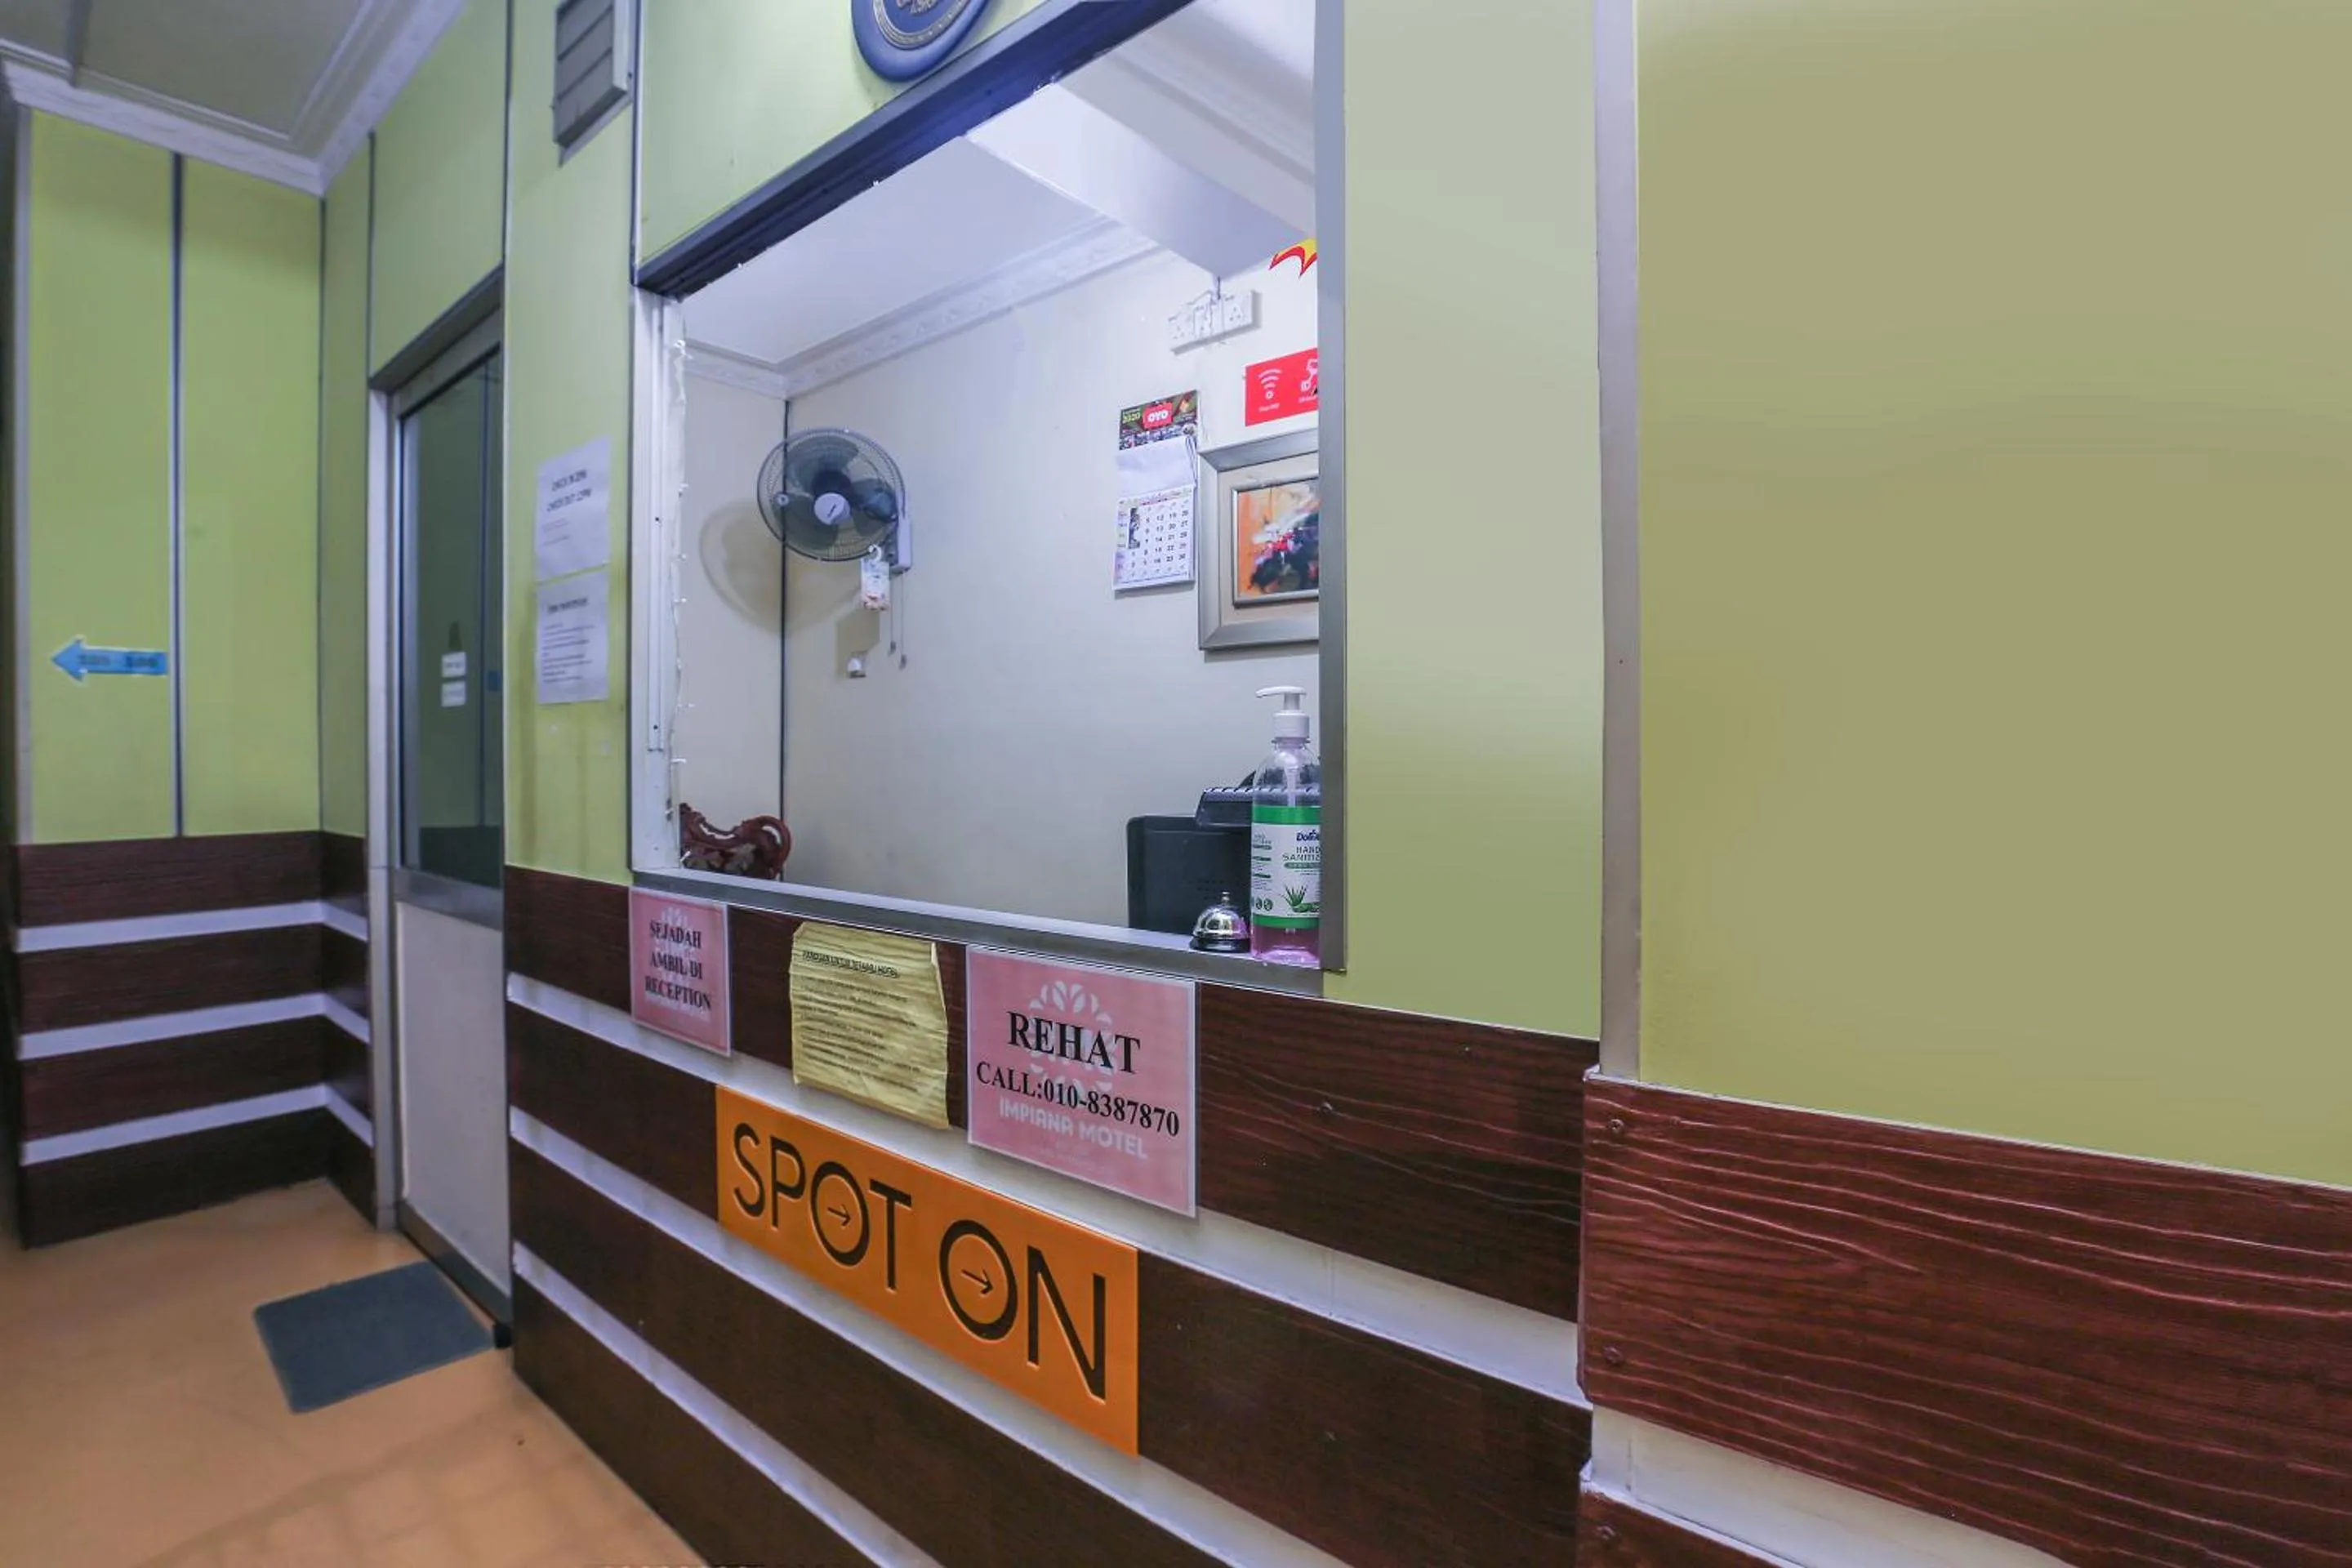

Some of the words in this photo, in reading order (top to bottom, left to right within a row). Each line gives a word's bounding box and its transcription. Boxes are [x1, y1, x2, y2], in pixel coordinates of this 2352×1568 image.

[1147, 410, 1169, 422] OYO
[649, 920, 702, 950] SEJADAH
[650, 951, 688, 976] AMBIL
[689, 960, 703, 980] DI
[644, 976, 711, 1011] RECEPTION
[1006, 1011, 1141, 1074] REHAT
[976, 1061, 1180, 1137] CALL:010-8387870
[999, 1095, 1074, 1136] IMPIANA
[1078, 1120, 1148, 1160] MOTEL
[733, 1122, 912, 1292] SPOT
[939, 1219, 1107, 1402] ON
